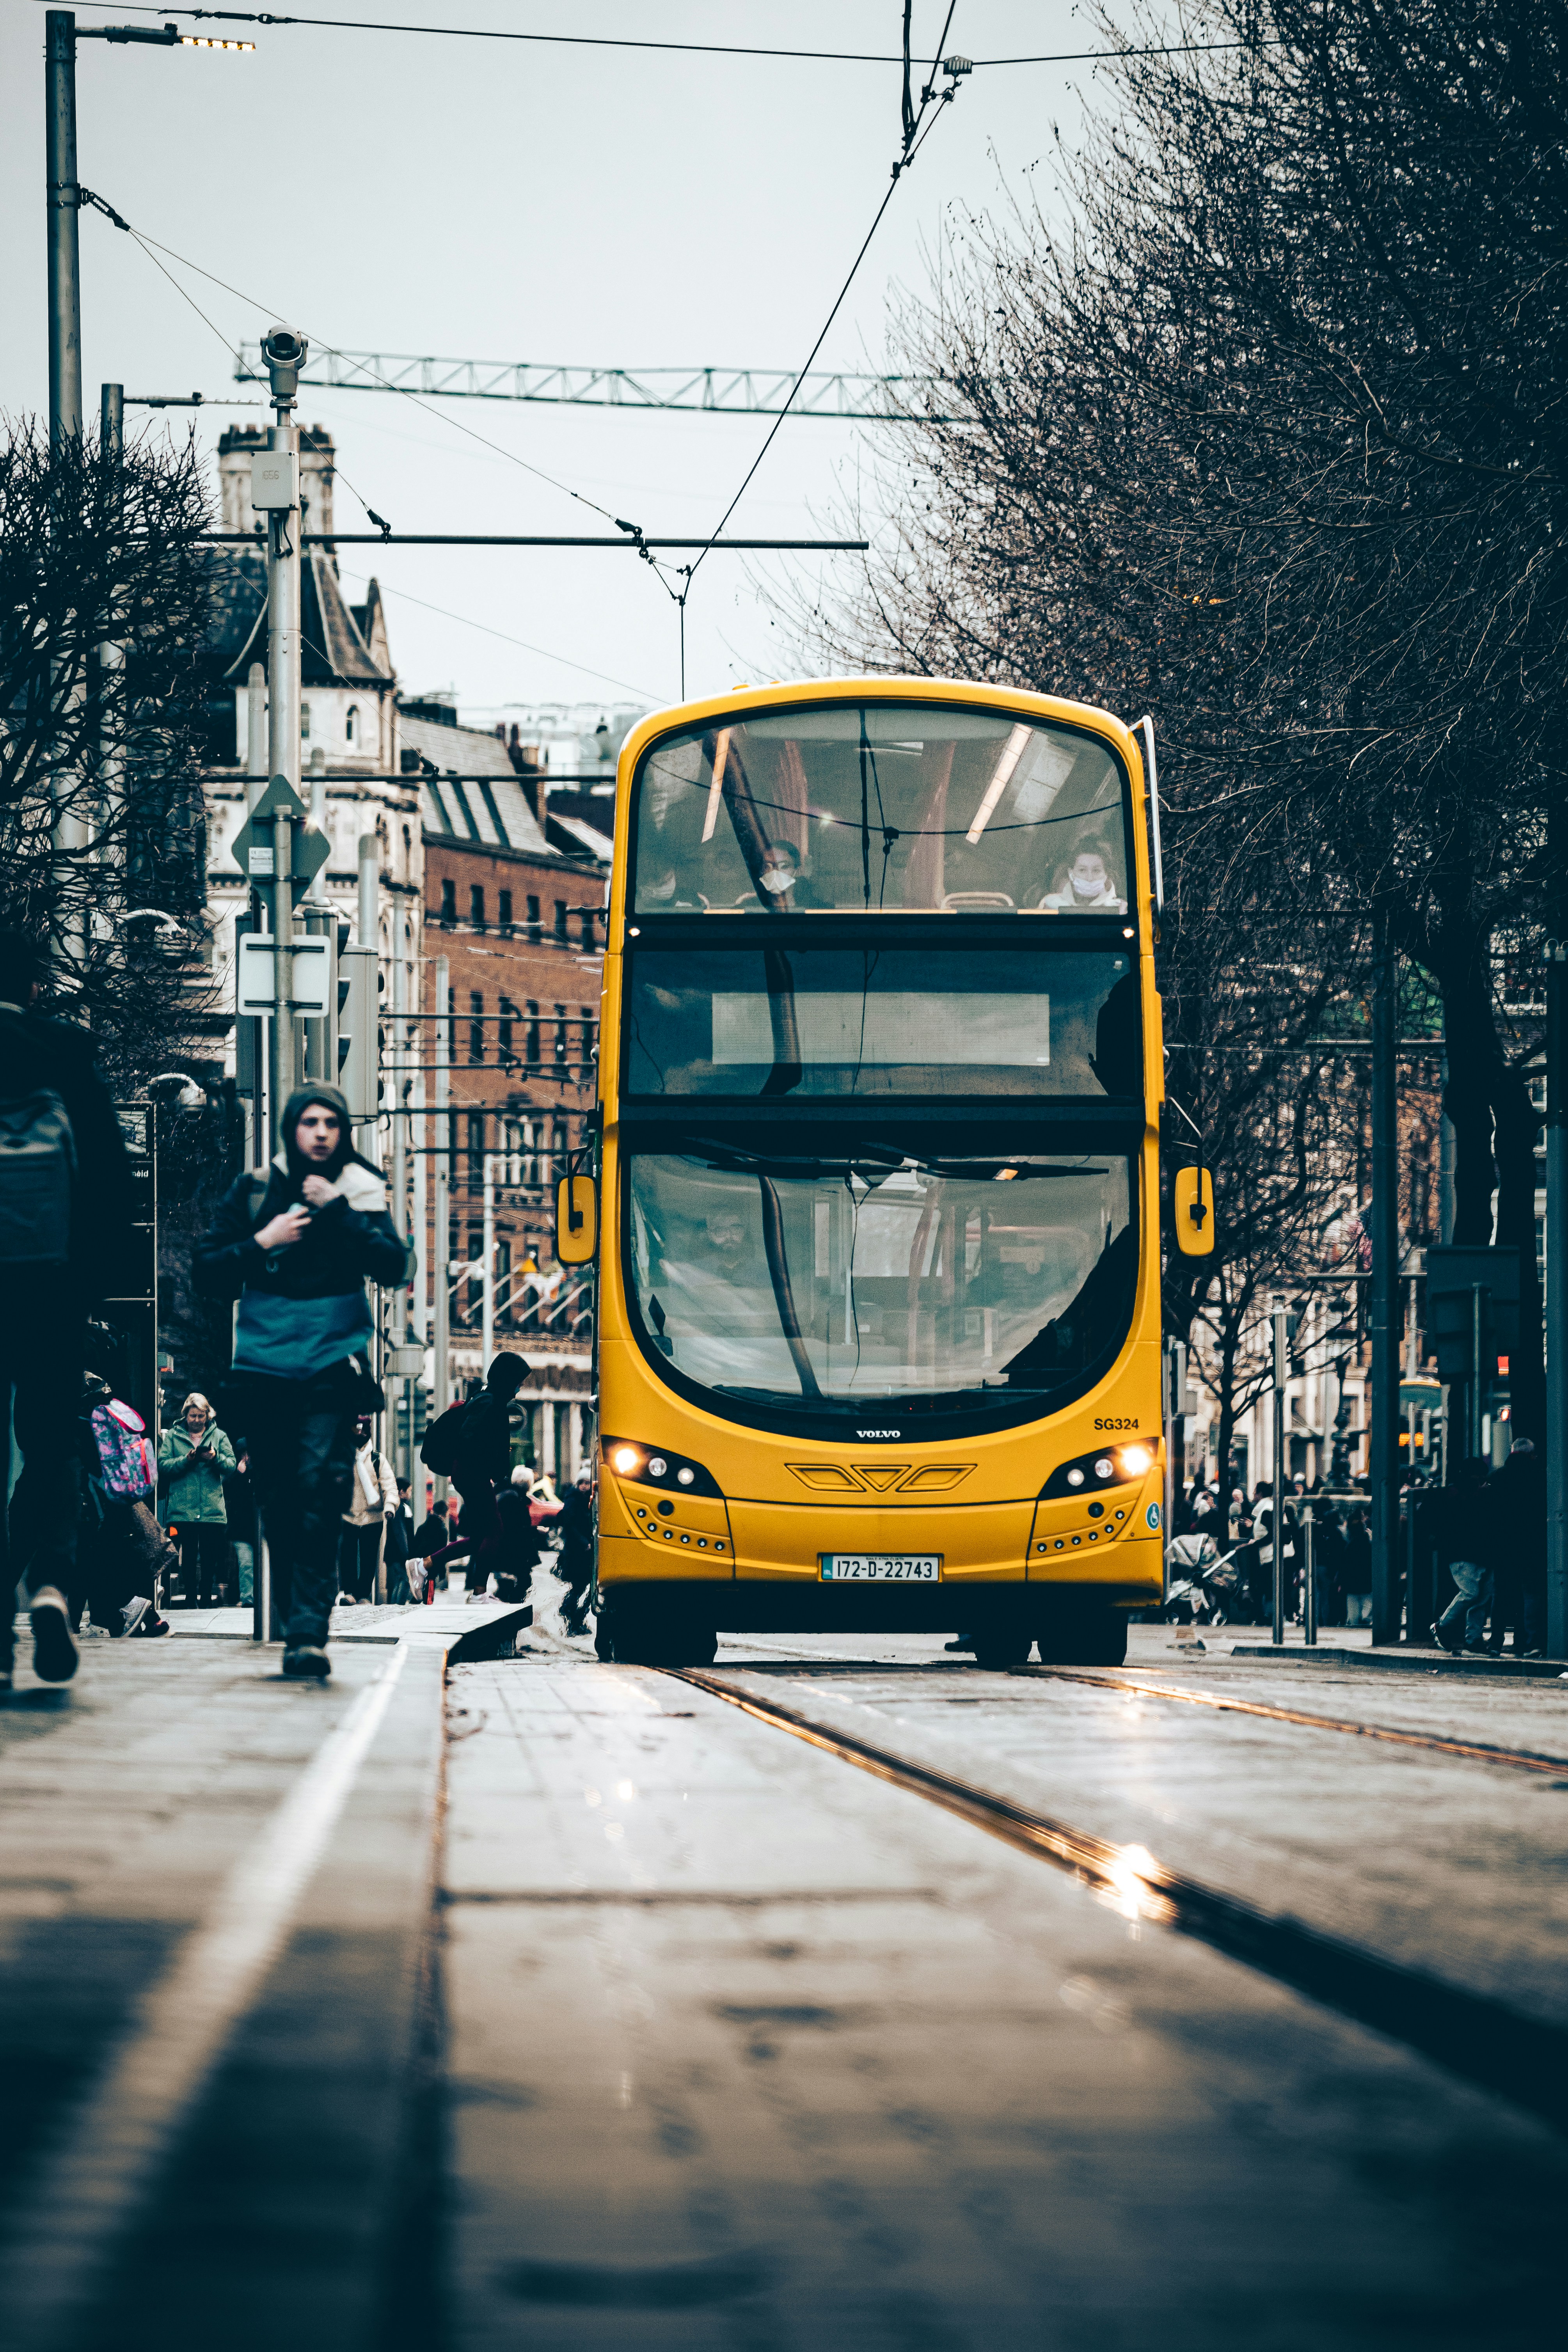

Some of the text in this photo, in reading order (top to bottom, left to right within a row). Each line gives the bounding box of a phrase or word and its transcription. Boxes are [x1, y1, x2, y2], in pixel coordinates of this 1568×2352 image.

[1094, 1418, 1139, 1430] SG324
[856, 1430, 901, 1438] VOLVO
[838, 1560, 932, 1578] 172-D-22743
